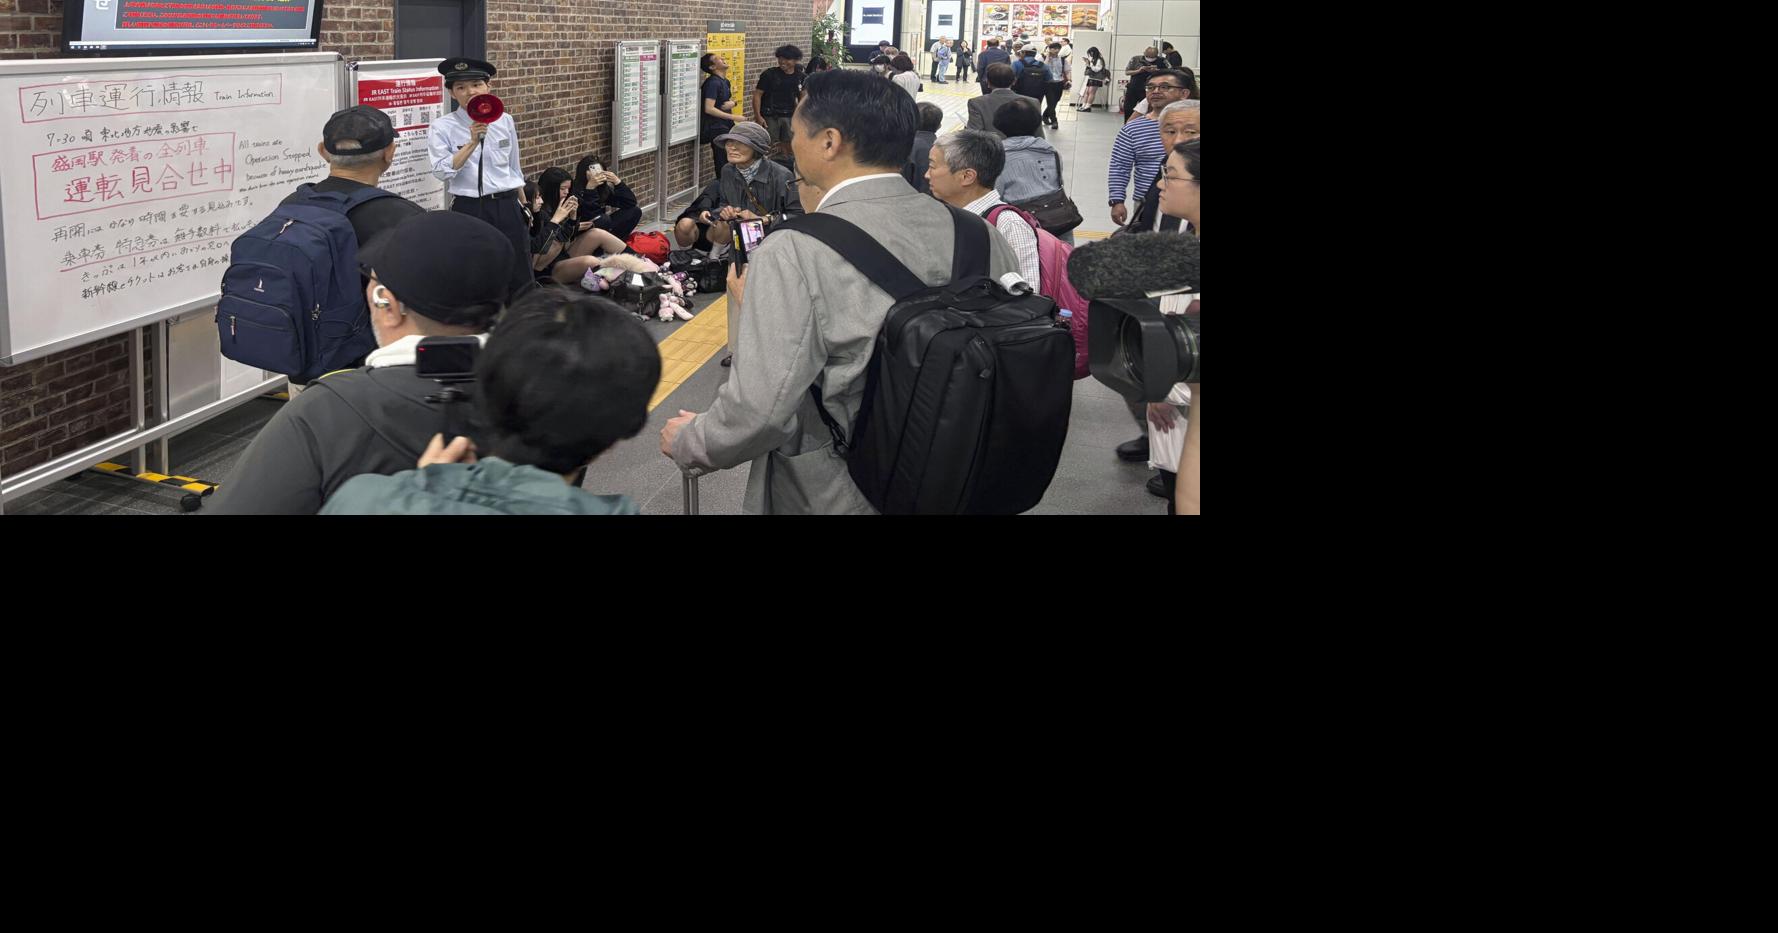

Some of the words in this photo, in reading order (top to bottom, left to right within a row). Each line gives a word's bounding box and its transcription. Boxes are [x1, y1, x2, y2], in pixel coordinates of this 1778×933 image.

[30, 80, 205, 116] 列車運行情報
[213, 91, 232, 101] Train
[237, 88, 274, 99] Information
[239, 140, 250, 150] All
[245, 153, 280, 166] Operation
[283, 146, 311, 163] Stopped
[64, 158, 232, 202] 運転見合せ中
